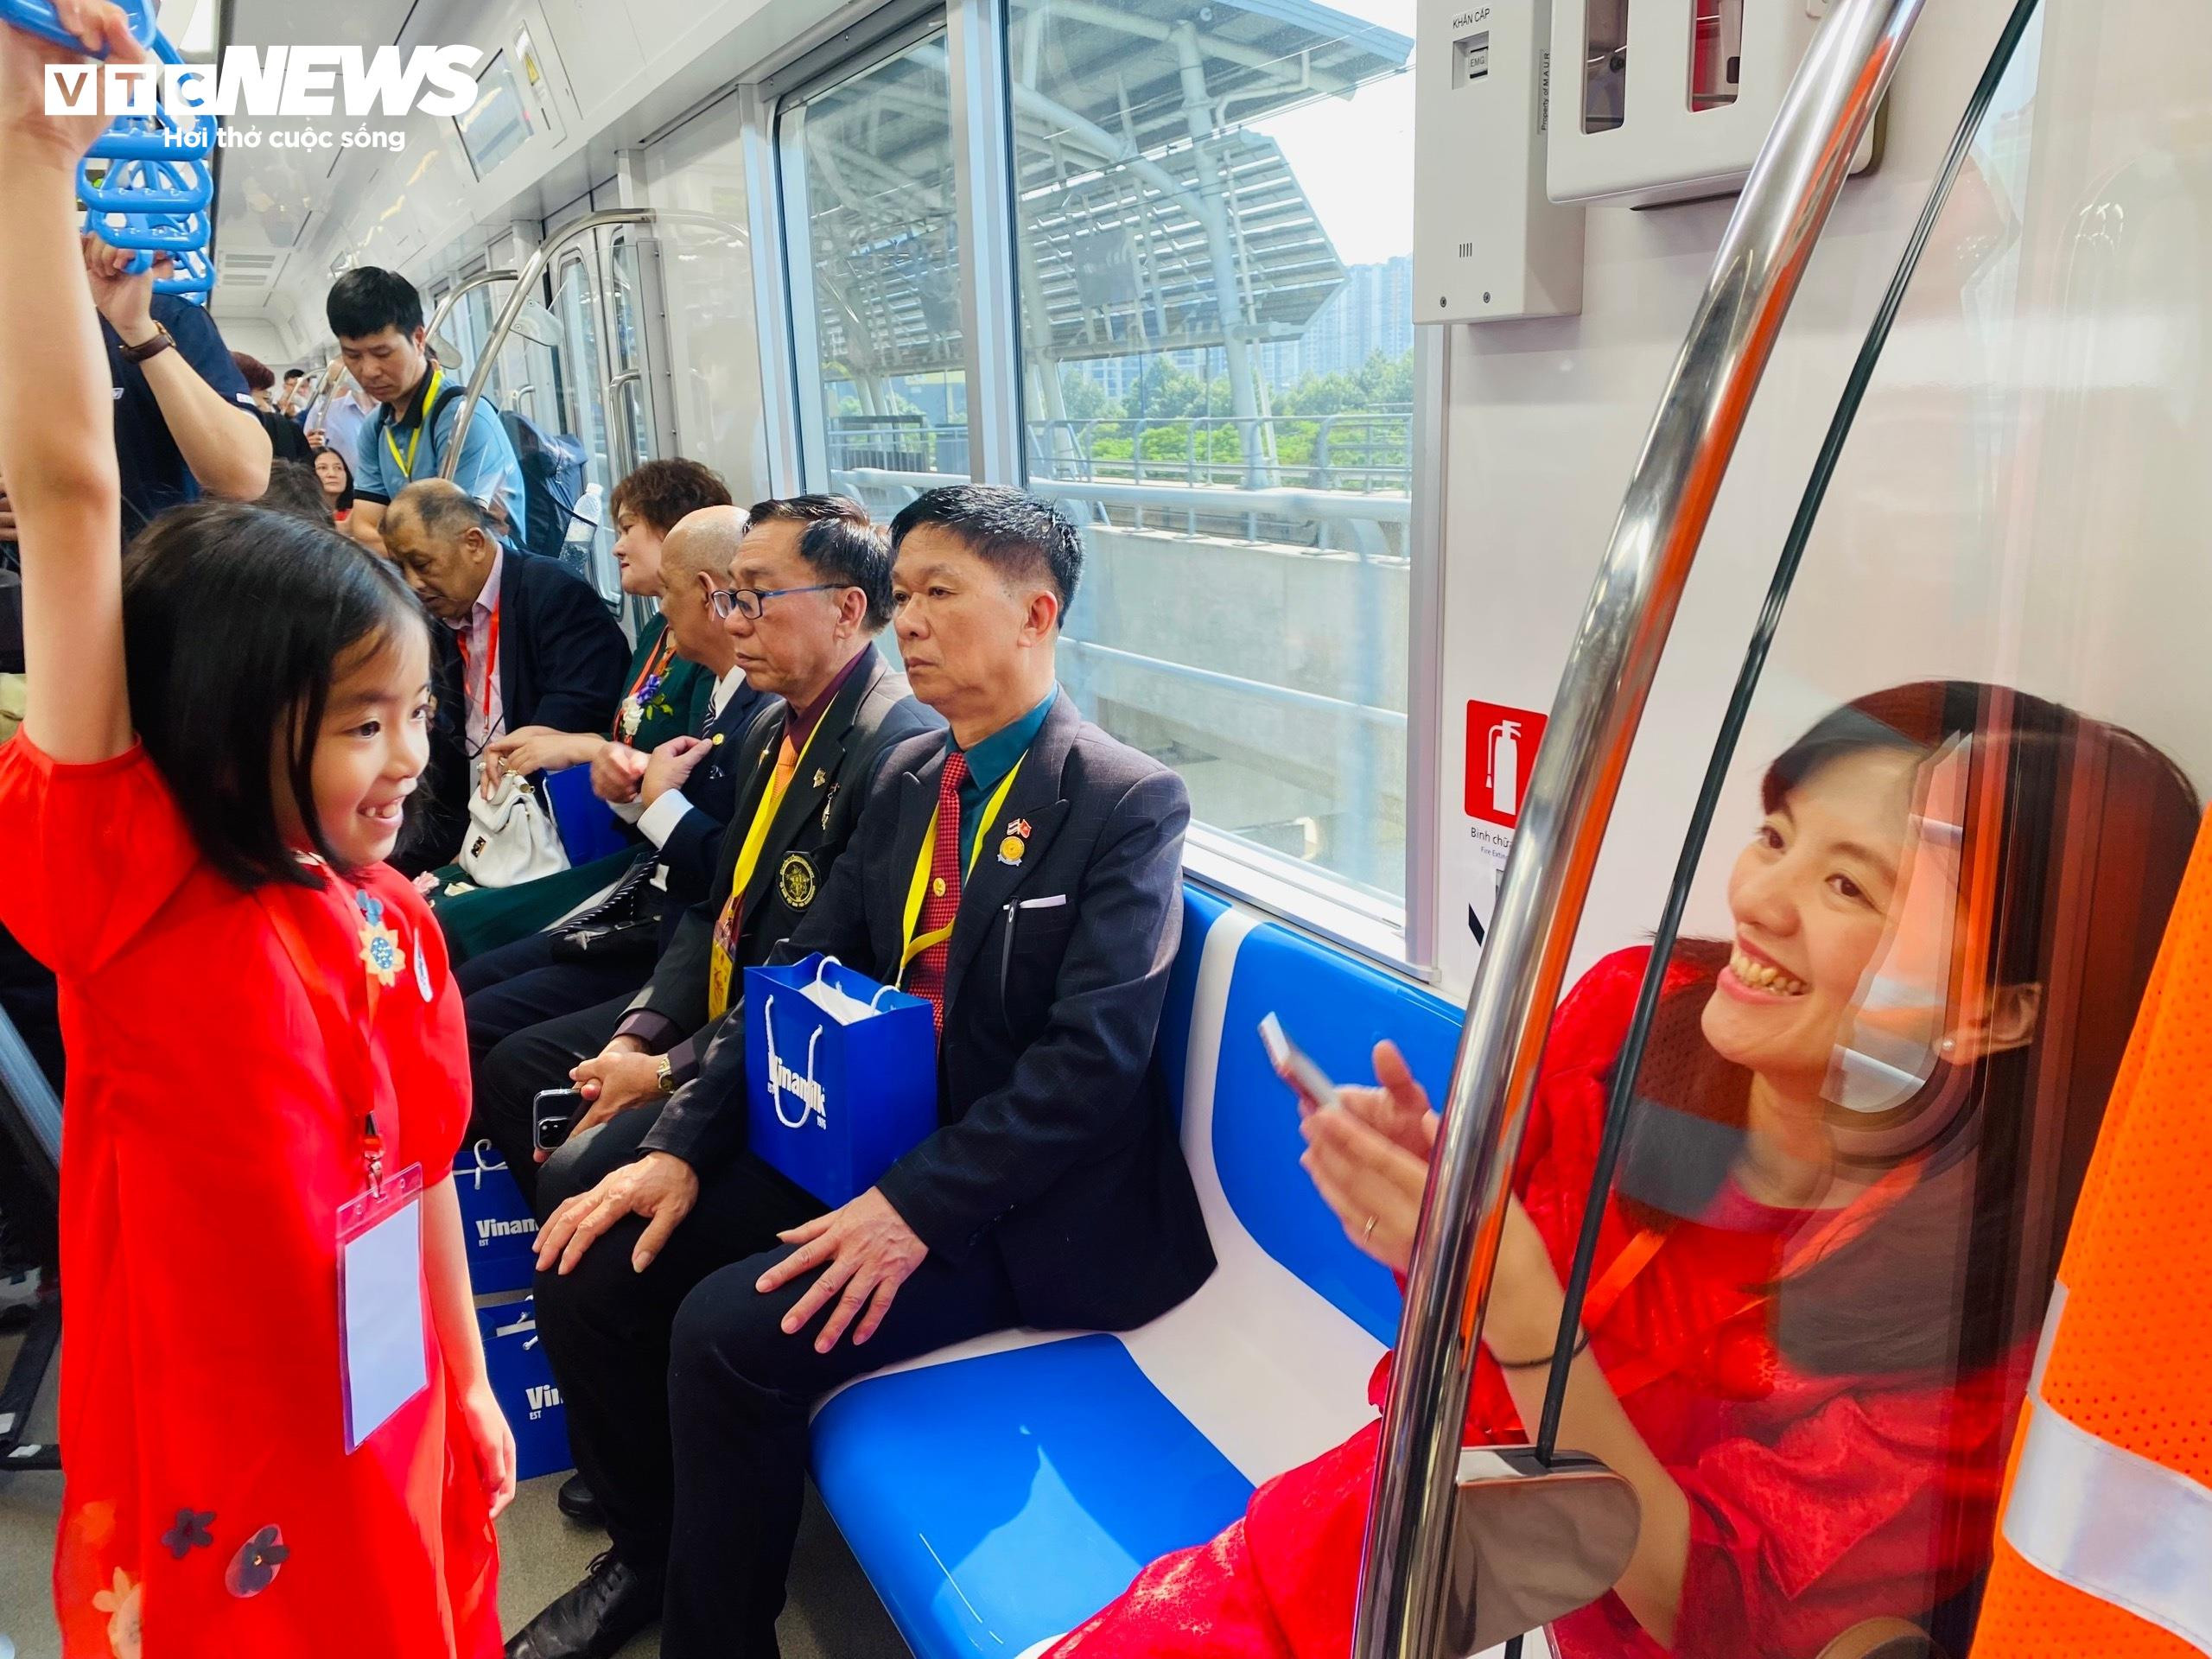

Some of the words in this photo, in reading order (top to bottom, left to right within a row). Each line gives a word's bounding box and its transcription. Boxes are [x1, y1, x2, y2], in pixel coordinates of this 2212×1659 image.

[1470, 56, 1485, 67] EMG
[1543, 87, 1549, 96] of
[1541, 99, 1549, 130] Property
[529, 1410, 542, 1421] EST
